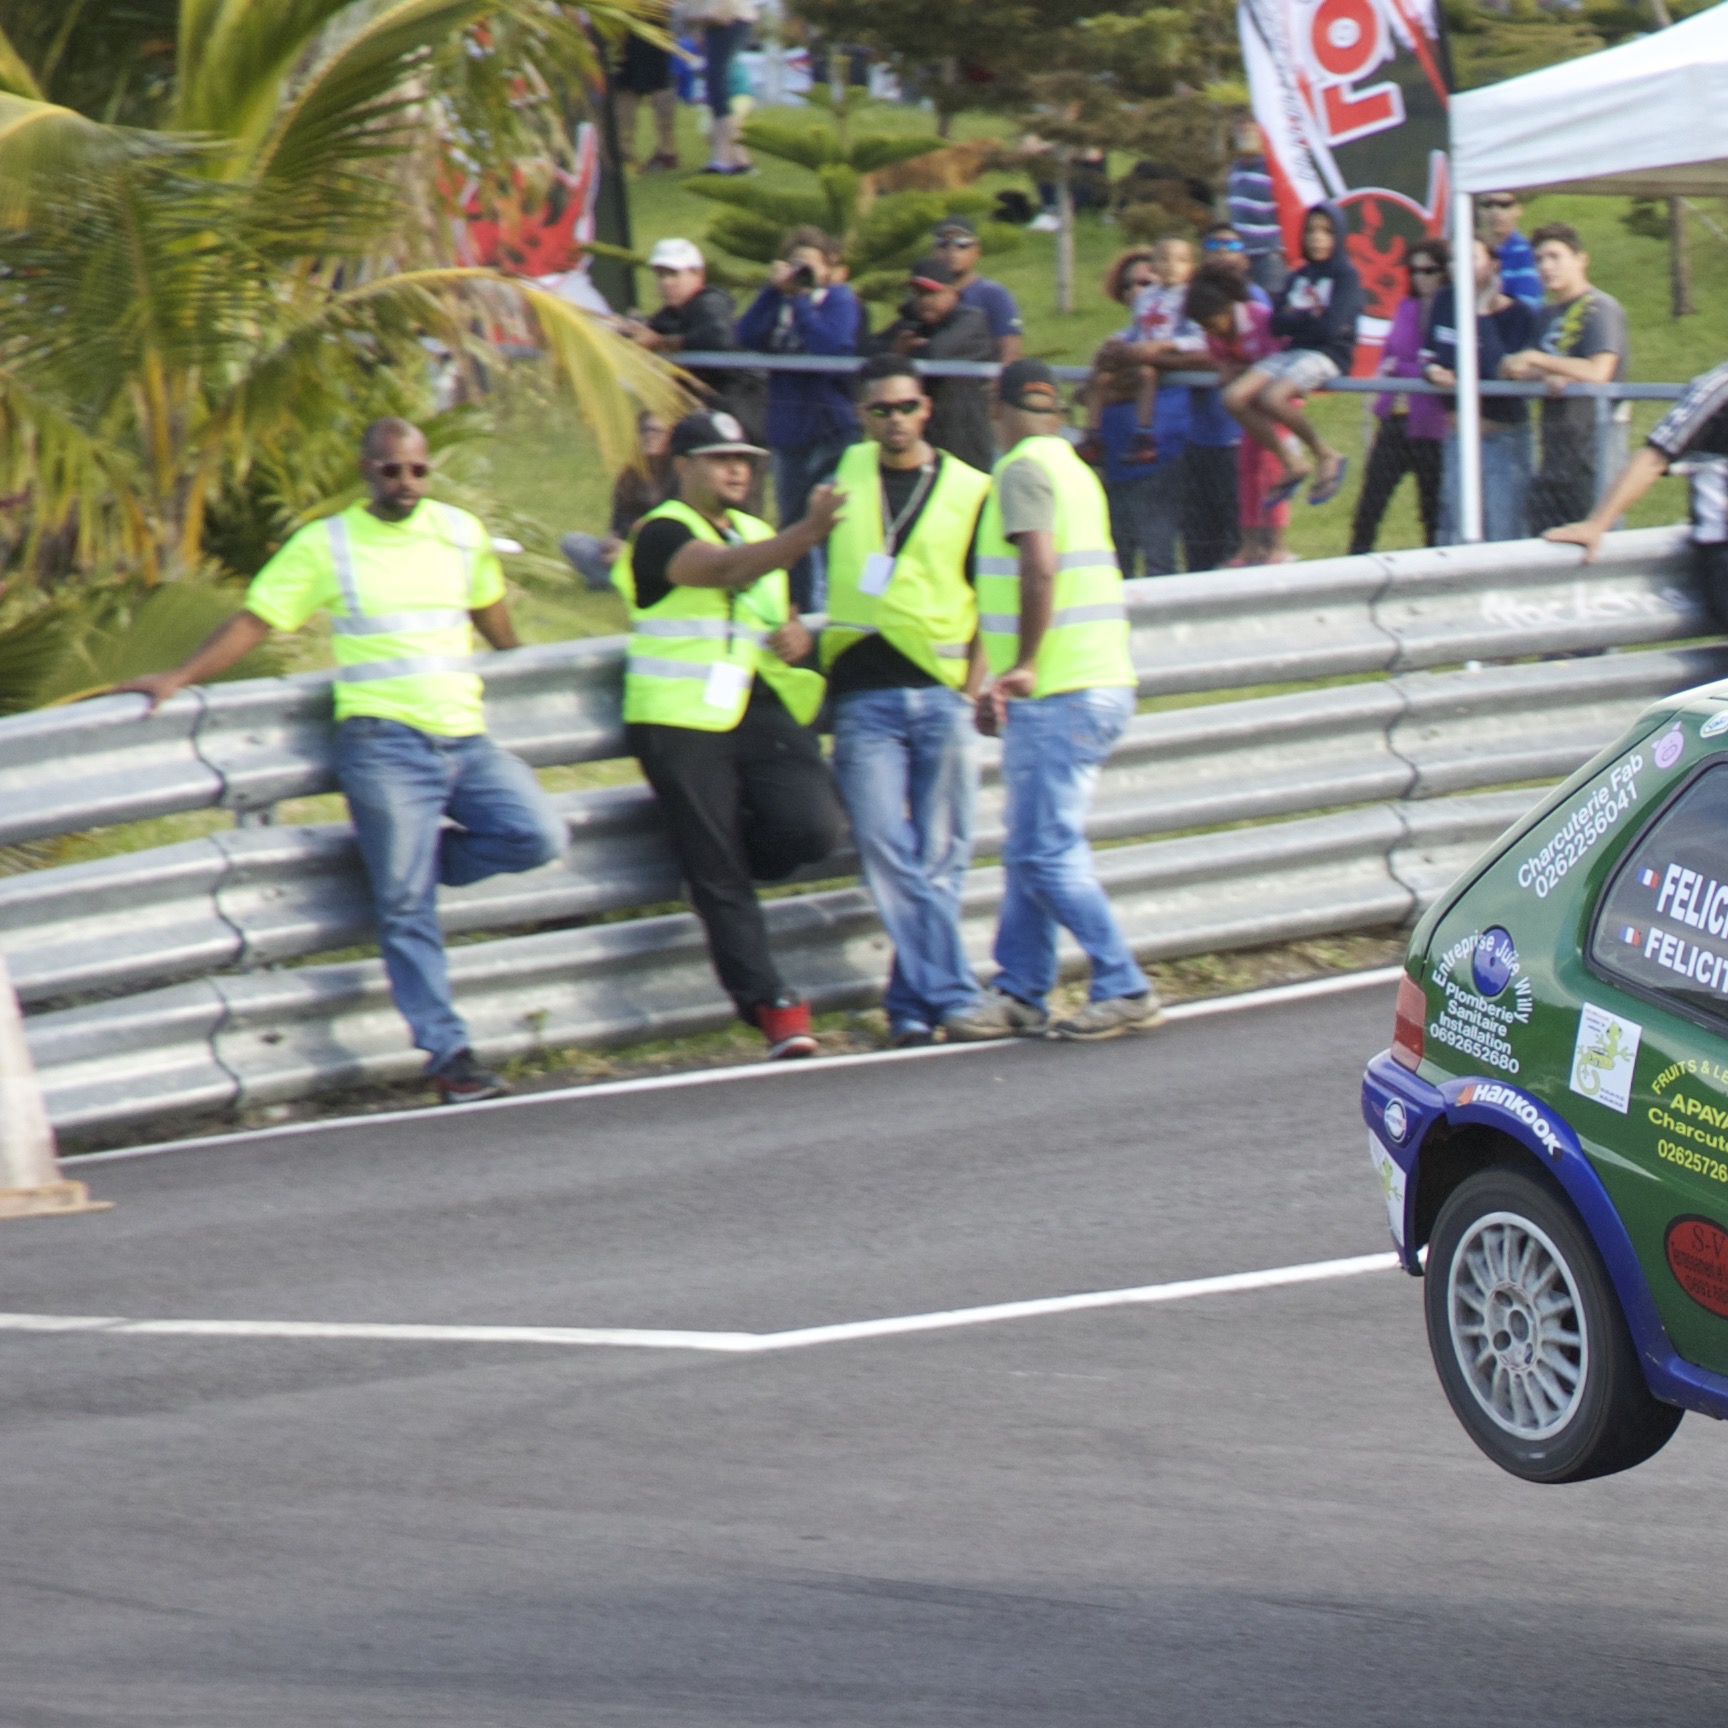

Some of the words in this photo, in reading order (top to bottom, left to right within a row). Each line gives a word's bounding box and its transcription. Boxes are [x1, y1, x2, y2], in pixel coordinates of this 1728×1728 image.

[1518, 787, 1610, 888] Charcuterie
[1610, 754, 1643, 792] Fab
[1535, 779, 1638, 898] 0262256041
[1431, 929, 1496, 988] Entreprise
[1514, 976, 1533, 1024] Willy
[1446, 982, 1514, 1023] Plomberie
[1447, 999, 1508, 1037] Sanitaire
[1430, 1023, 1520, 1074] 0692652680
[1439, 1011, 1512, 1056] Installation
[1651, 1059, 1698, 1095] FRUITS
[1700, 1060, 1710, 1075] &
